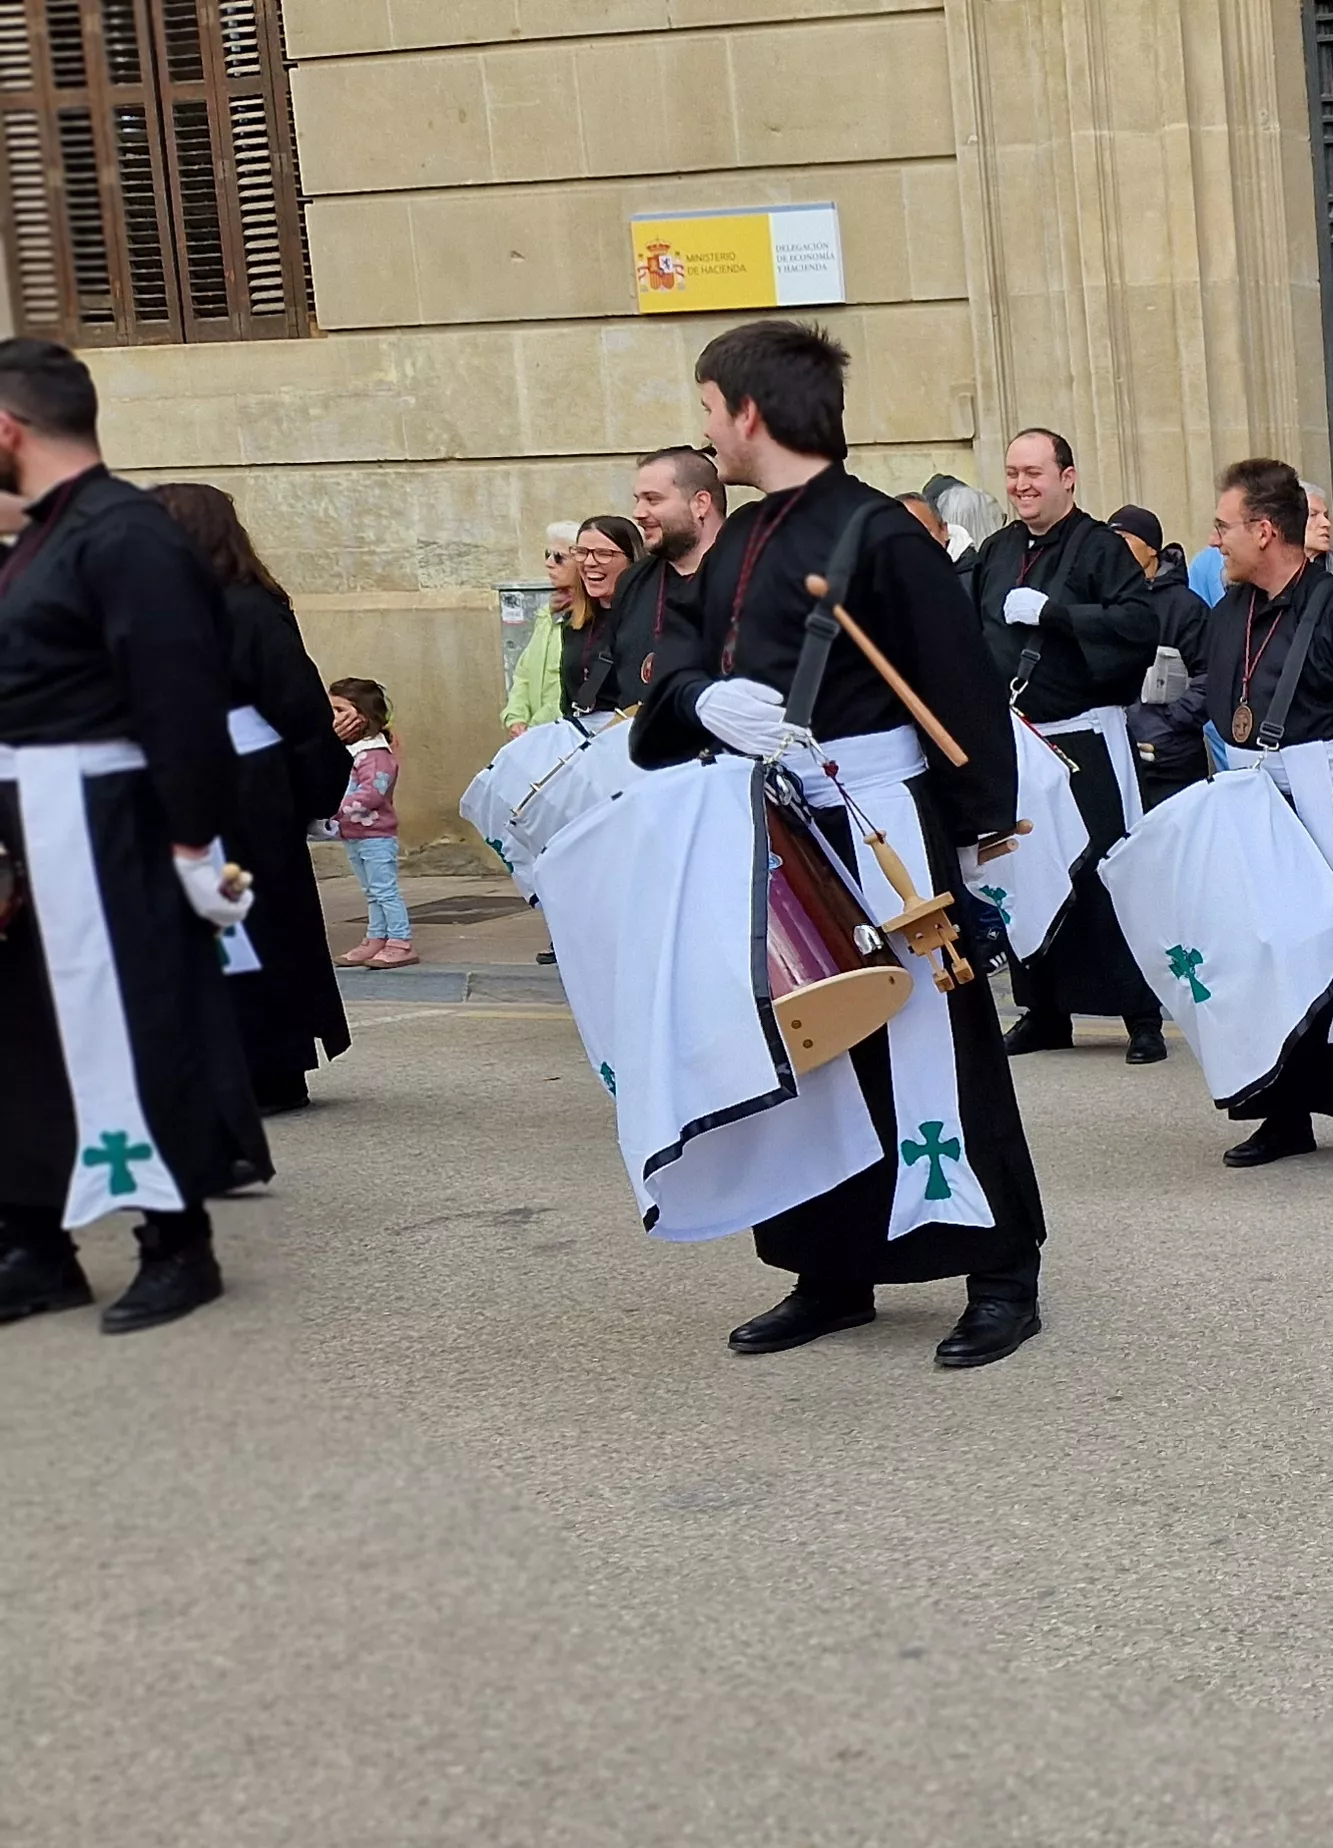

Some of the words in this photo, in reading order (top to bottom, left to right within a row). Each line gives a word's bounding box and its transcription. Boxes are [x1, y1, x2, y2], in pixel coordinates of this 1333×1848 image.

[686, 252, 736, 262] MINISTERIO
[687, 266, 700, 276] DE
[701, 264, 747, 275] HACIENDA
